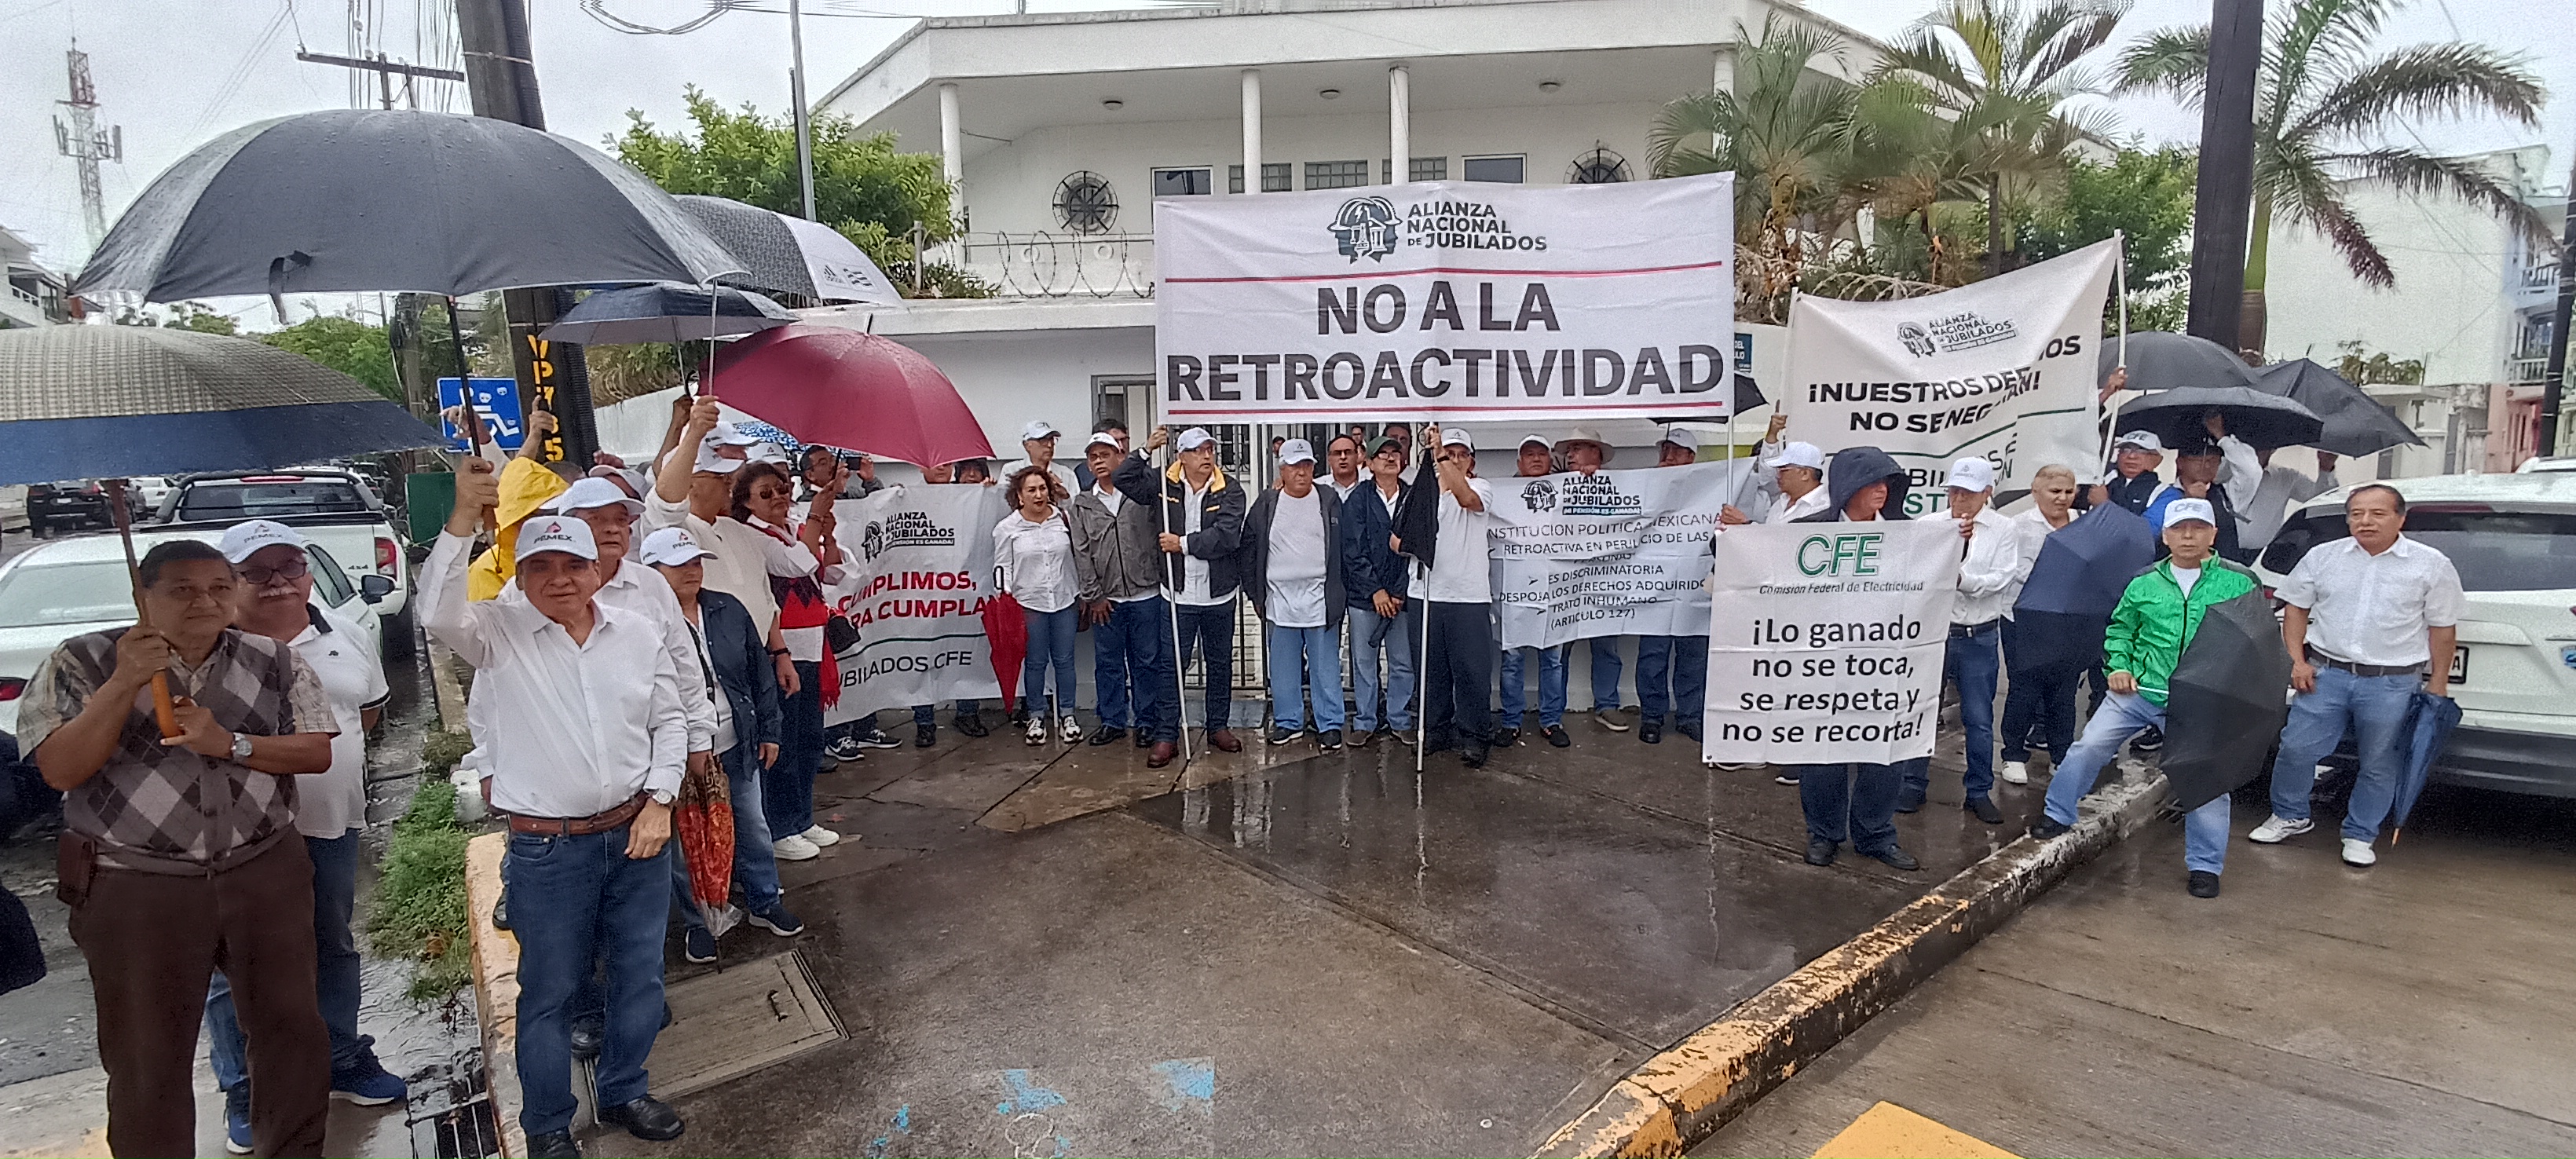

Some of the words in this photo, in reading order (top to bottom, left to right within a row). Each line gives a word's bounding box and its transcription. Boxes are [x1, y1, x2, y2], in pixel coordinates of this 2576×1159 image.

[1408, 202, 1497, 218] ALIANZA
[1407, 217, 1512, 234] NACIONAL
[1407, 238, 1422, 247] DE
[1425, 232, 1548, 250] JUBILADOS
[1318, 284, 1407, 335] NO
[1419, 280, 1465, 331] A
[1480, 283, 1561, 331] LA
[1929, 313, 1977, 328] ALIANZA
[1932, 318, 1989, 336] NACIONAL
[1947, 320, 2013, 343] JUBILADOS
[1167, 344, 1725, 402] RETROACTIVIDAD
[1809, 378, 1984, 403] ¡NUESTROS
[1850, 412, 1899, 431] NO
[1905, 413, 1947, 433] SE
[1562, 485, 1620, 495] NACIONAL
[1563, 475, 1612, 487] ALIANZA
[1572, 495, 1641, 506] JUBILADOS
[2174, 503, 2203, 513] CFE
[885, 519, 936, 534] NACIONAL
[886, 511, 928, 525] ALIANZA
[244, 533, 282, 543] PEMEX
[534, 534, 573, 544] PEMEX
[891, 528, 955, 540] JUBILADOS
[1487, 524, 1574, 539] NSTITUCION
[1578, 521, 1642, 536] POLITICA
[1504, 543, 1584, 554] RETROACTIVA
[1586, 542, 1602, 551] EN
[1667, 533, 1682, 543] DE
[1687, 531, 1709, 542] LAS
[1795, 532, 1885, 579] CFE
[1549, 574, 1560, 584] ES
[1562, 564, 1665, 582] DISCRIMINATORIA
[1552, 586, 1569, 599] LOS
[1572, 580, 1632, 594] DERECHOS
[1635, 579, 1706, 592] ADQUIRID
[1807, 581, 1845, 594] Federal
[1847, 581, 1860, 593] de
[1863, 580, 1924, 593] Electricidad
[877, 594, 997, 619] CUMPLA
[1553, 597, 1581, 613] TRATO
[1550, 609, 1605, 631] (ARTICULO
[1608, 608, 1636, 620] 127)
[1753, 618, 1800, 645] ¡Lo
[1809, 613, 1922, 649] ganado
[839, 656, 928, 688] BILADOS
[934, 651, 973, 669] CFE
[1752, 658, 1793, 678] no
[1802, 658, 1836, 678] se
[1845, 654, 1915, 679] toca,
[1740, 692, 1774, 711] se
[1784, 688, 1900, 716] respeta
[1906, 688, 1920, 714] y
[1722, 722, 1762, 741] no
[1770, 726, 1805, 744] se
[1814, 712, 1924, 743] recorta!
